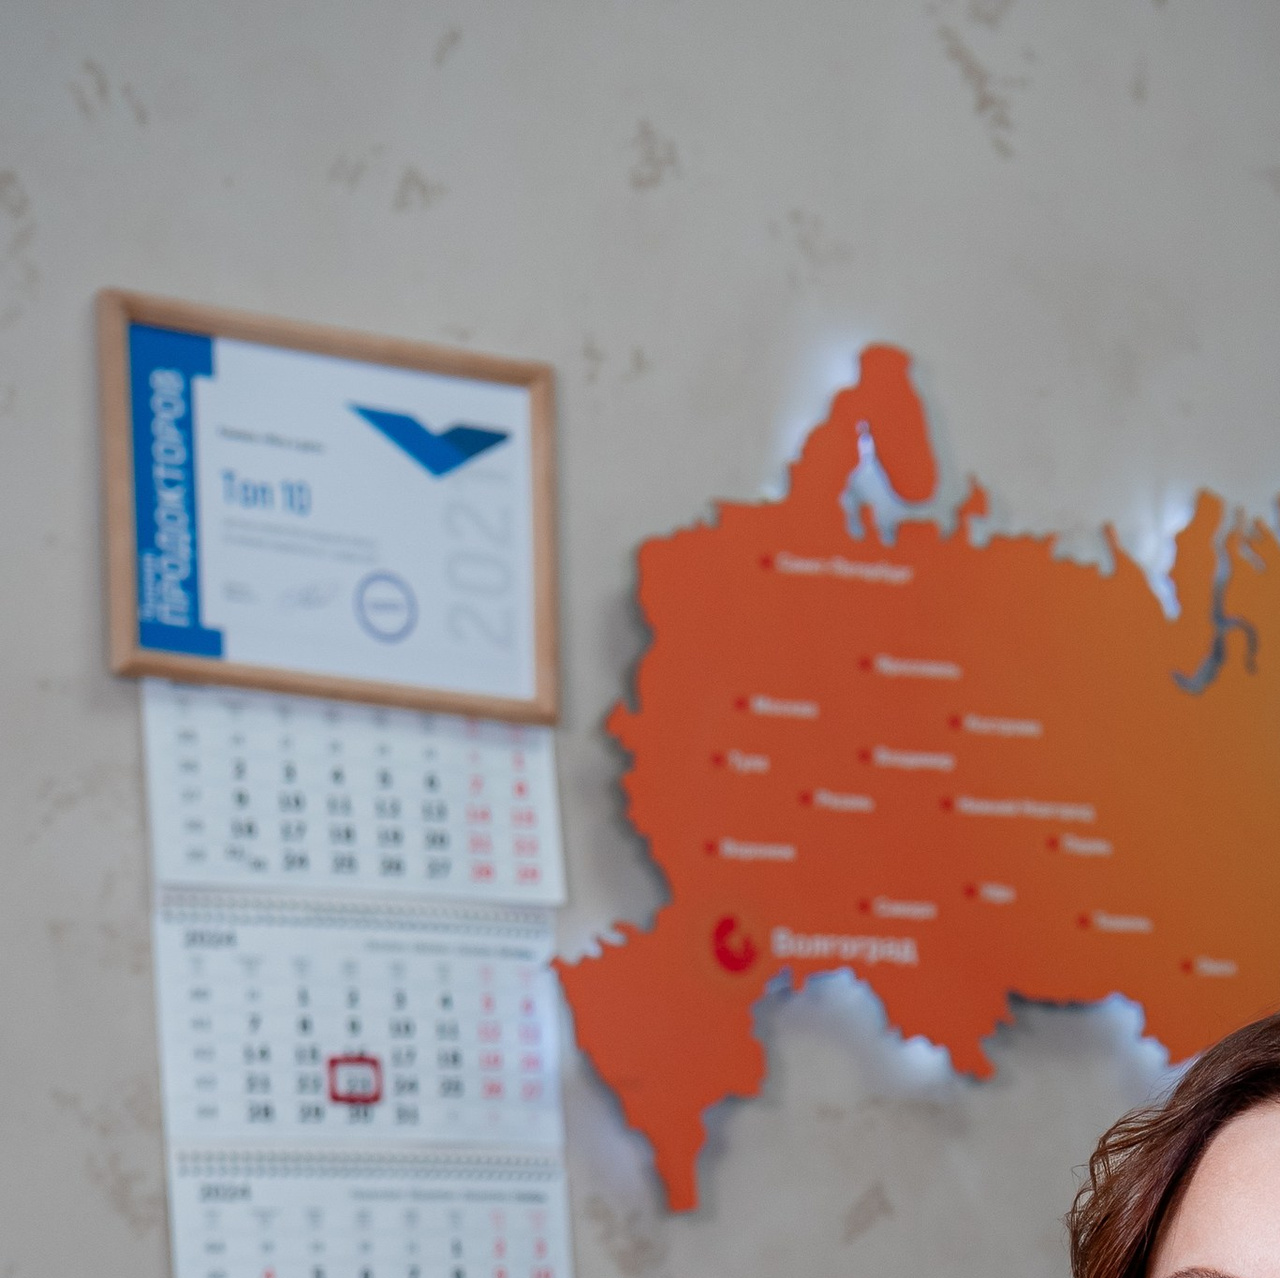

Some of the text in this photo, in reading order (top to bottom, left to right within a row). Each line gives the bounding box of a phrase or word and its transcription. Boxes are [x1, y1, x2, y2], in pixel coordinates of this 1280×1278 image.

[151, 369, 190, 626] ПРОДОКТОРОВ
[220, 467, 312, 516] Топ 10
[750, 694, 819, 717] Москва
[727, 749, 770, 773] Тула
[183, 930, 237, 949] 2024
[771, 927, 917, 965] Волгоград
[199, 1183, 251, 1203] 2024
